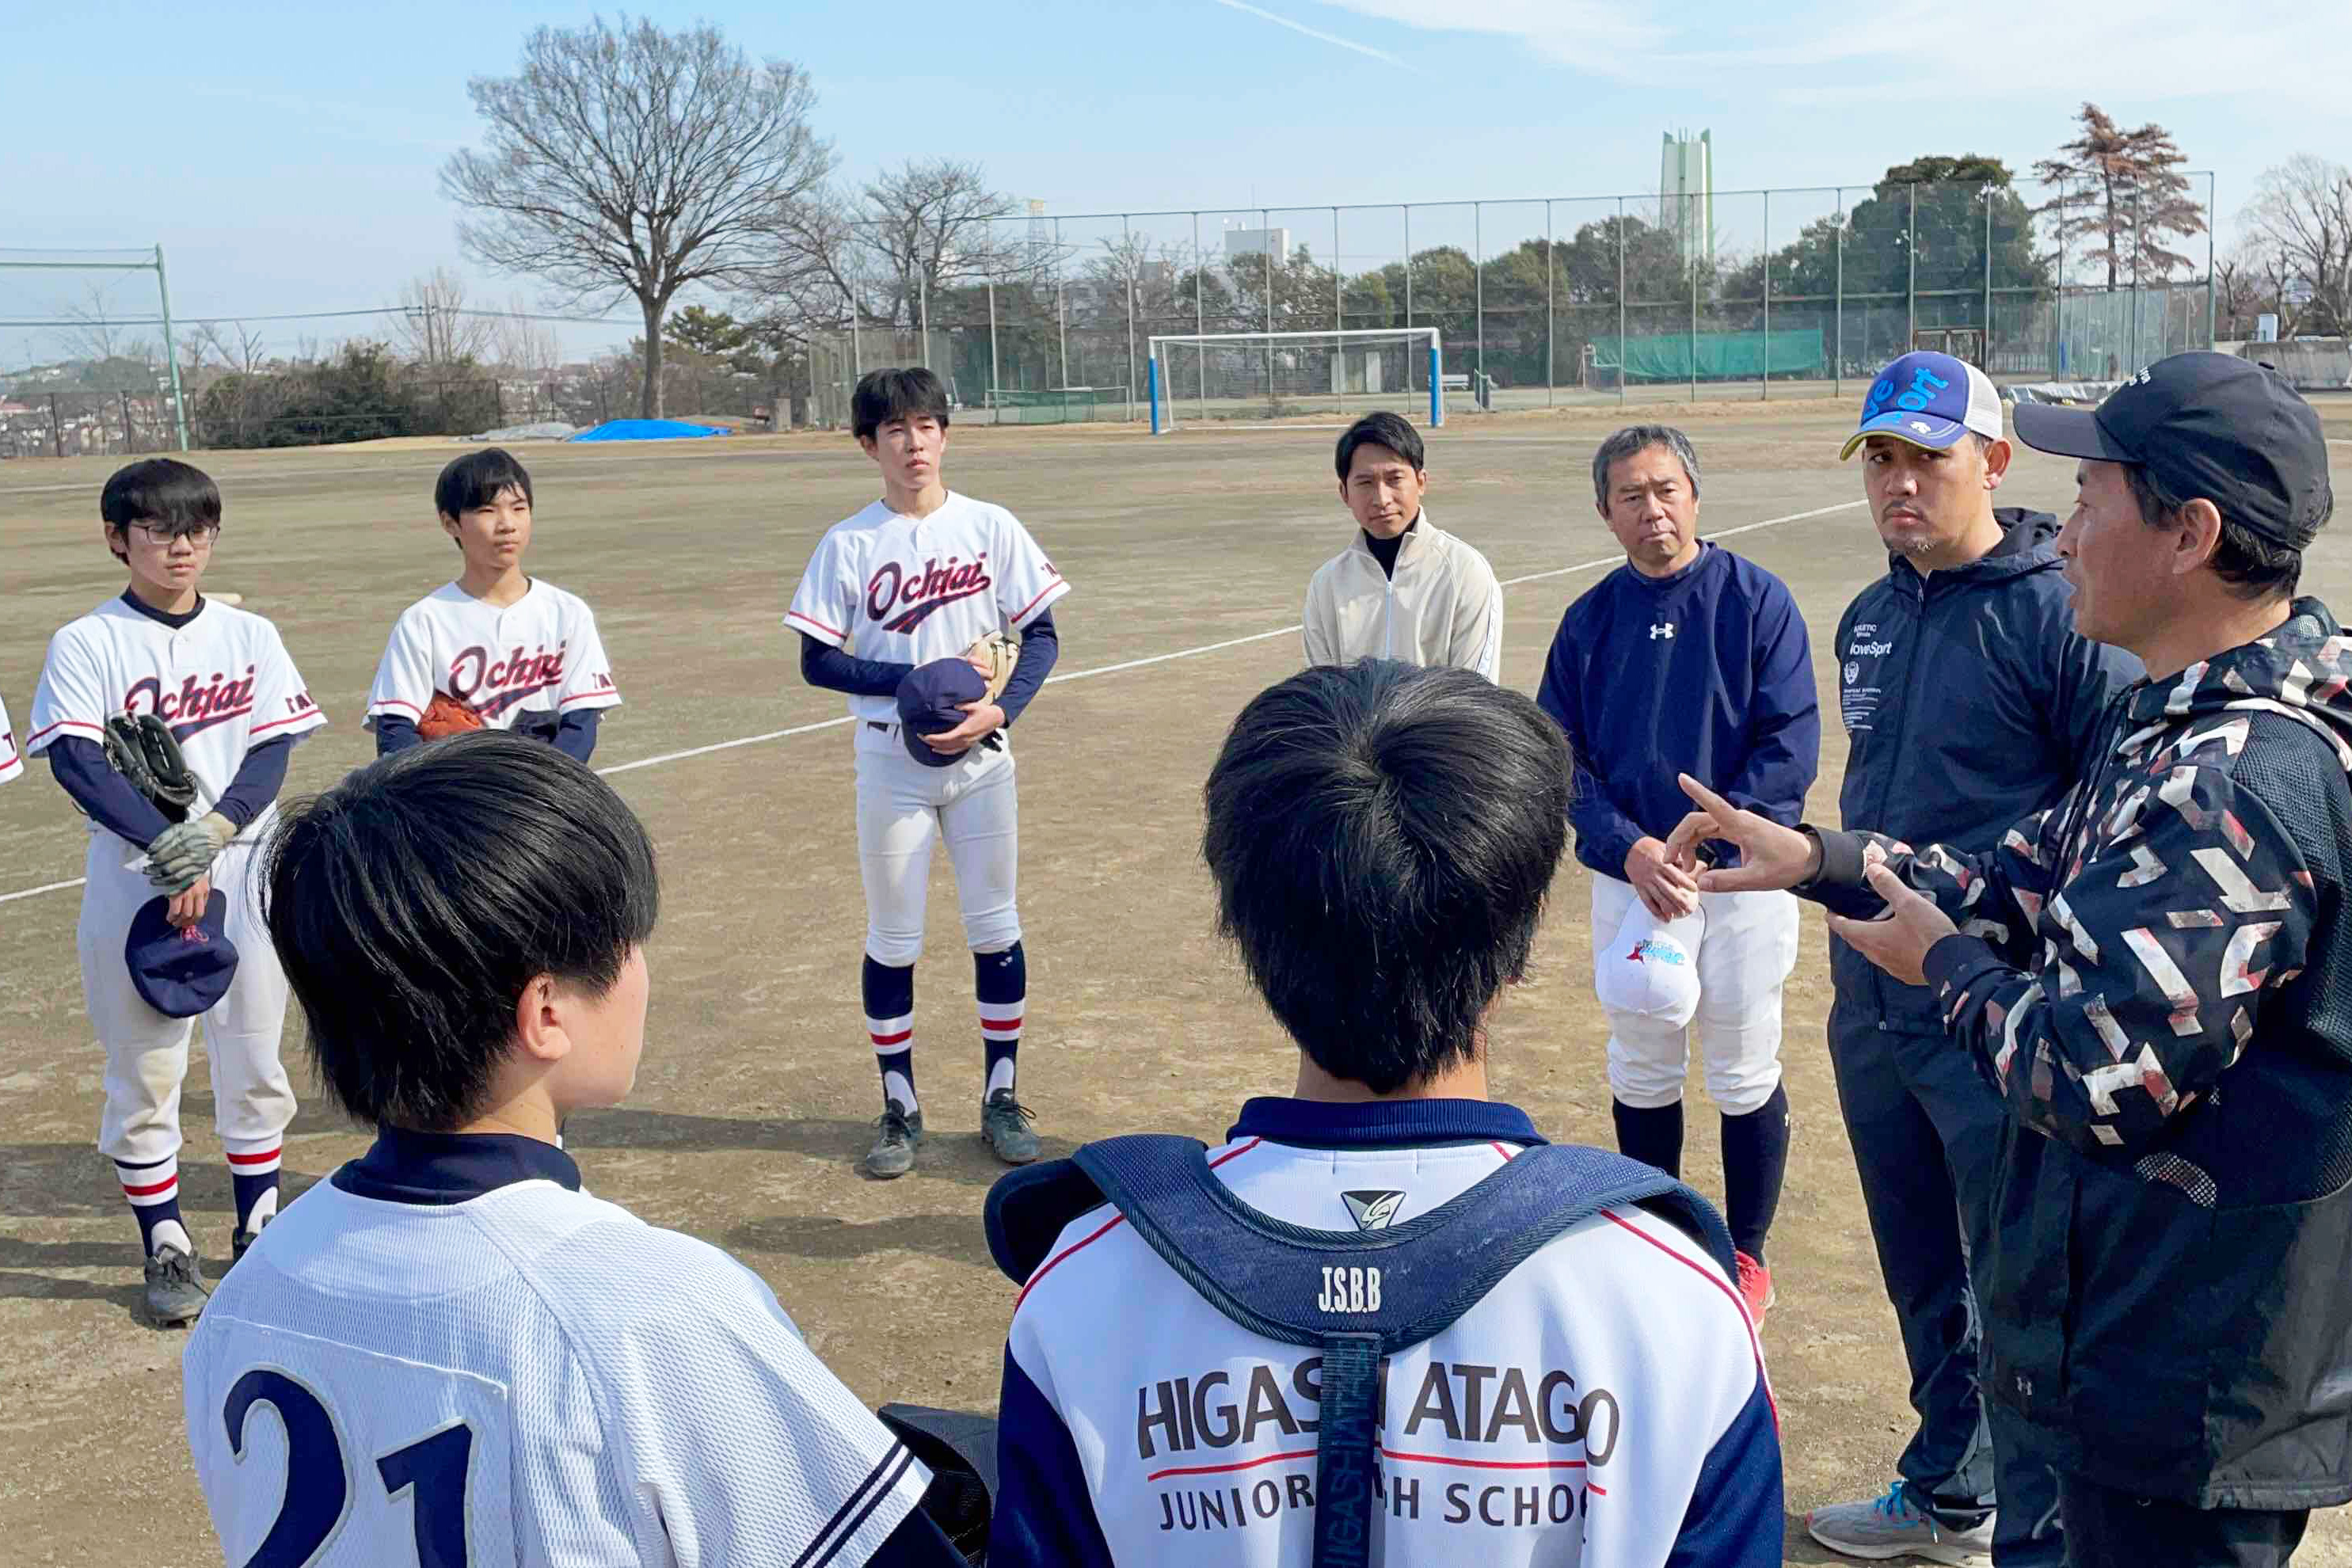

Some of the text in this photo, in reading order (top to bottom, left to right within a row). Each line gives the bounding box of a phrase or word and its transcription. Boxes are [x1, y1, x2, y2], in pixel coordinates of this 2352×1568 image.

[866, 552, 991, 621] Ochiai
[124, 664, 255, 722] Ochiai
[447, 640, 567, 700] Ochiai
[1403, 1361, 1619, 1467] ATAGO
[222, 1364, 478, 1568] 21
[1159, 1474, 1316, 1531] JUNIOR
[1444, 1482, 1588, 1526] SCHO
